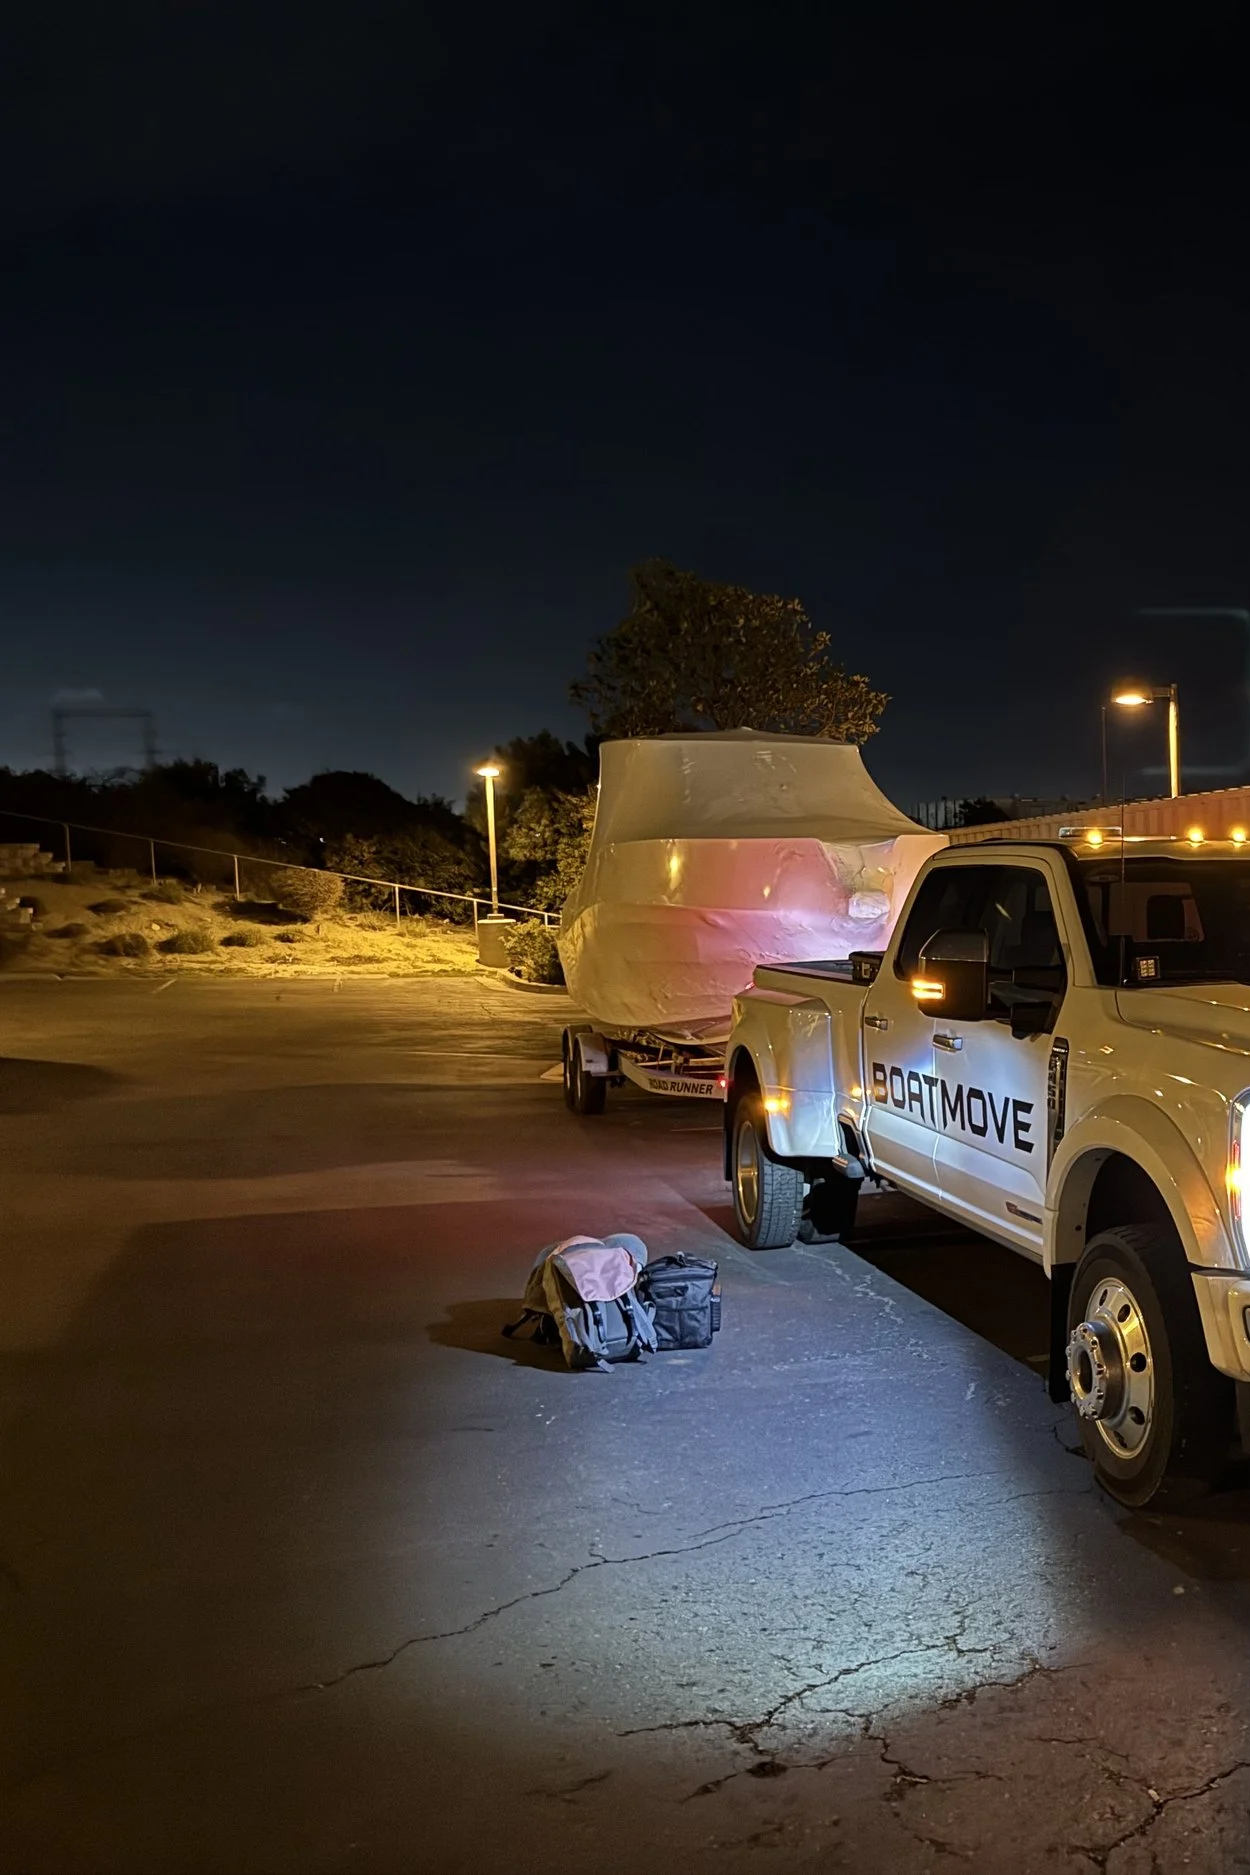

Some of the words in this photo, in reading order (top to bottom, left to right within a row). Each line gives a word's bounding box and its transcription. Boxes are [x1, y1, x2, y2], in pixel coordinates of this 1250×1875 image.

[648, 1078, 668, 1091] ROAD
[670, 1081, 713, 1095] RUNNER
[873, 1062, 1035, 1154] BOATMOVE
